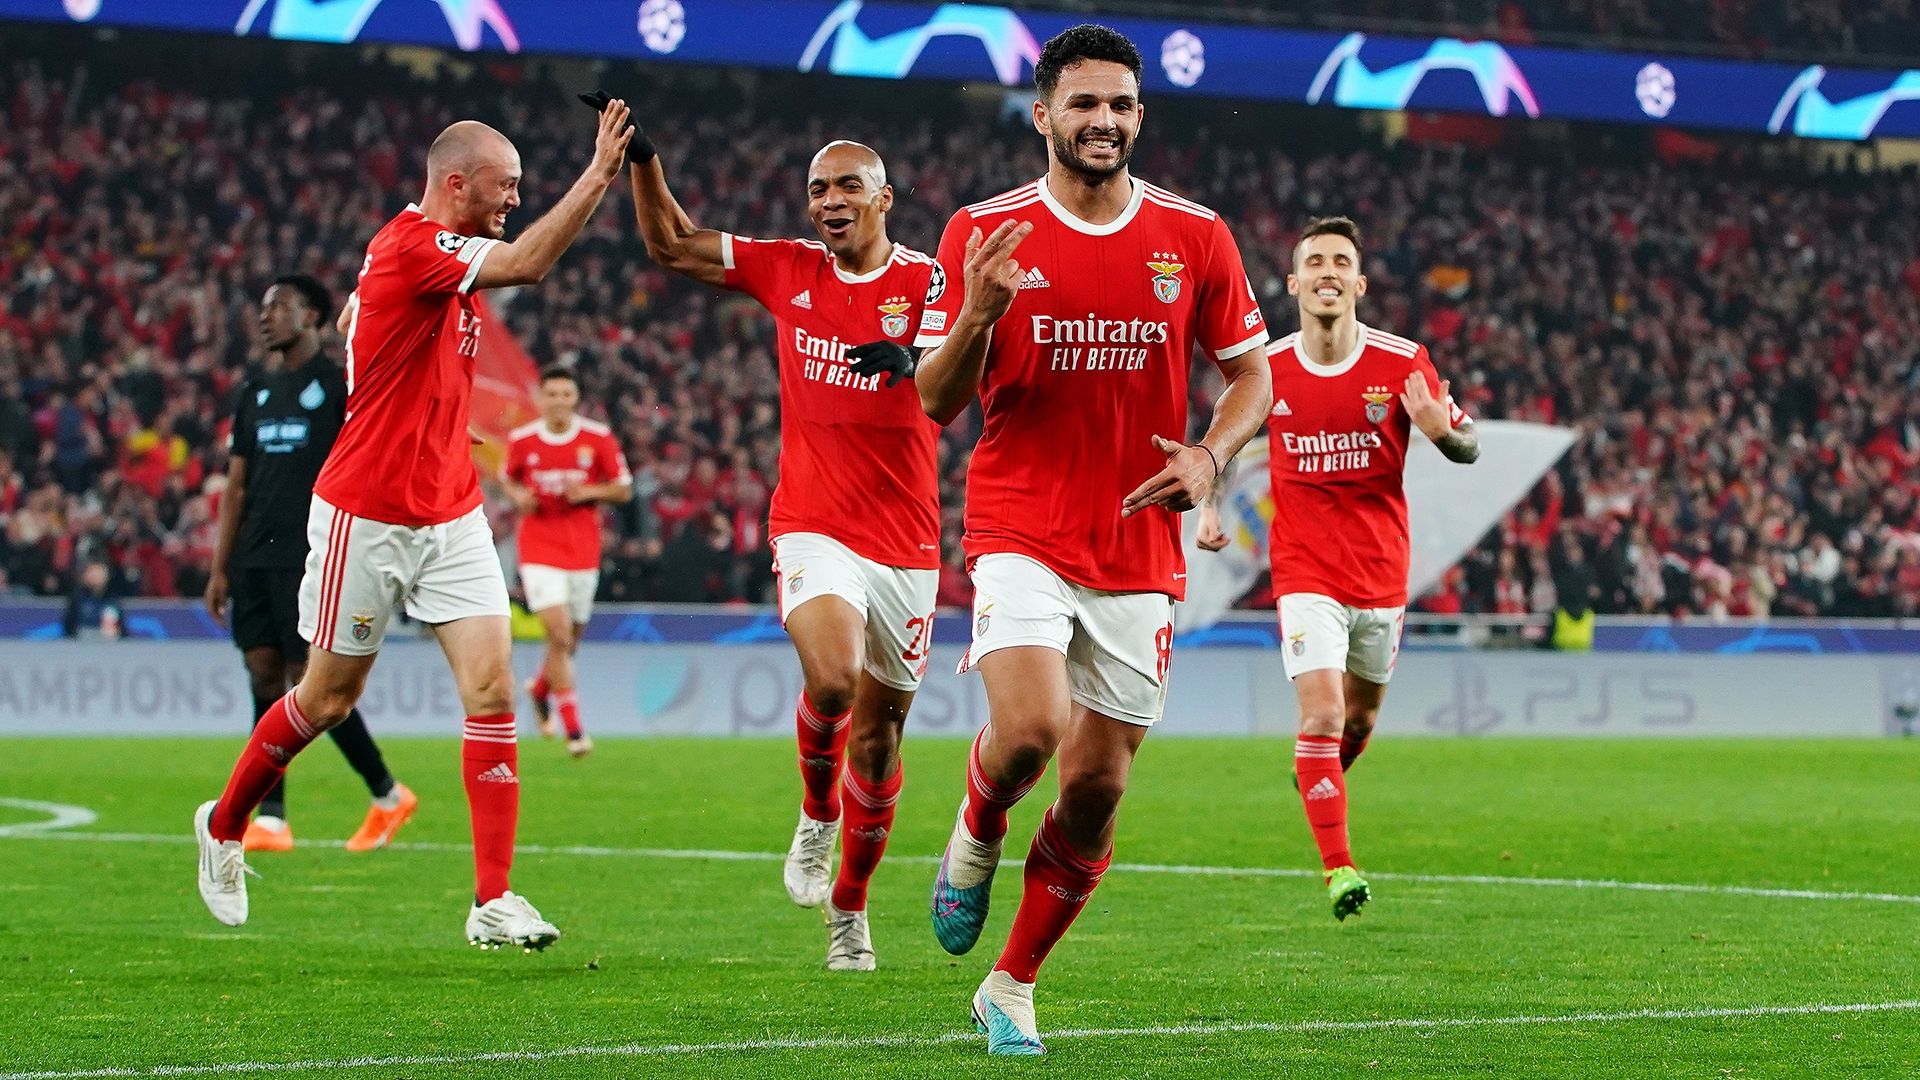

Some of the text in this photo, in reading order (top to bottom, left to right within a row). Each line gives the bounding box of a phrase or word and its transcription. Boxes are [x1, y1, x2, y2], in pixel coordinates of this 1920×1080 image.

[1018, 279, 1050, 290] adidas
[924, 315, 945, 324] ATION
[1031, 312, 1168, 344] Emirates
[795, 327, 862, 365] Emir
[804, 359, 825, 382] FLY
[1051, 347, 1148, 371] FLY BETTER
[1281, 430, 1382, 454] Emirates
[1298, 451, 1370, 473] FLY BETTER
